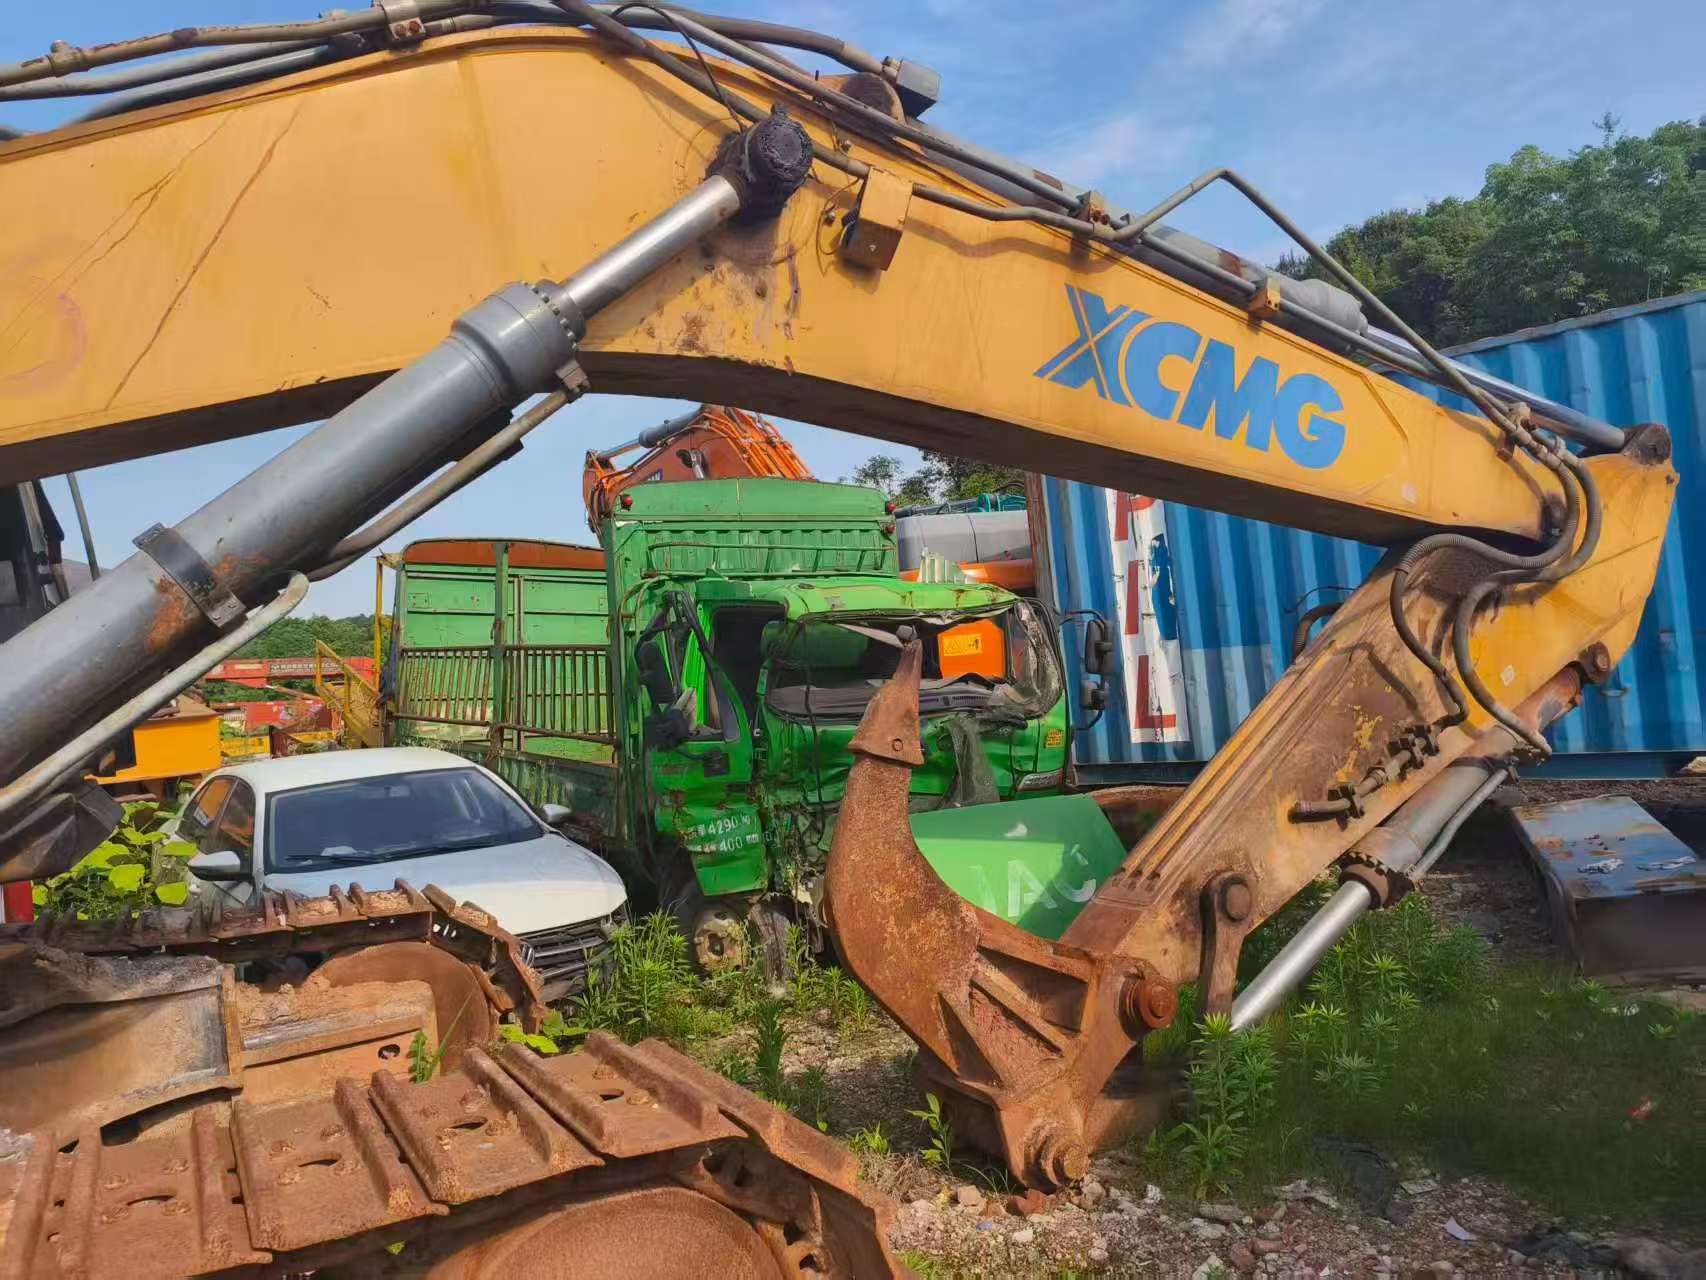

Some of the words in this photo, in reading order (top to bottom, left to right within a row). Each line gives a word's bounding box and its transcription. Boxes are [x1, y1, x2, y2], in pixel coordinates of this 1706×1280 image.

[1033, 283, 1346, 469] XCMG
[708, 815, 738, 834] 4290
[720, 836, 743, 852] 400
